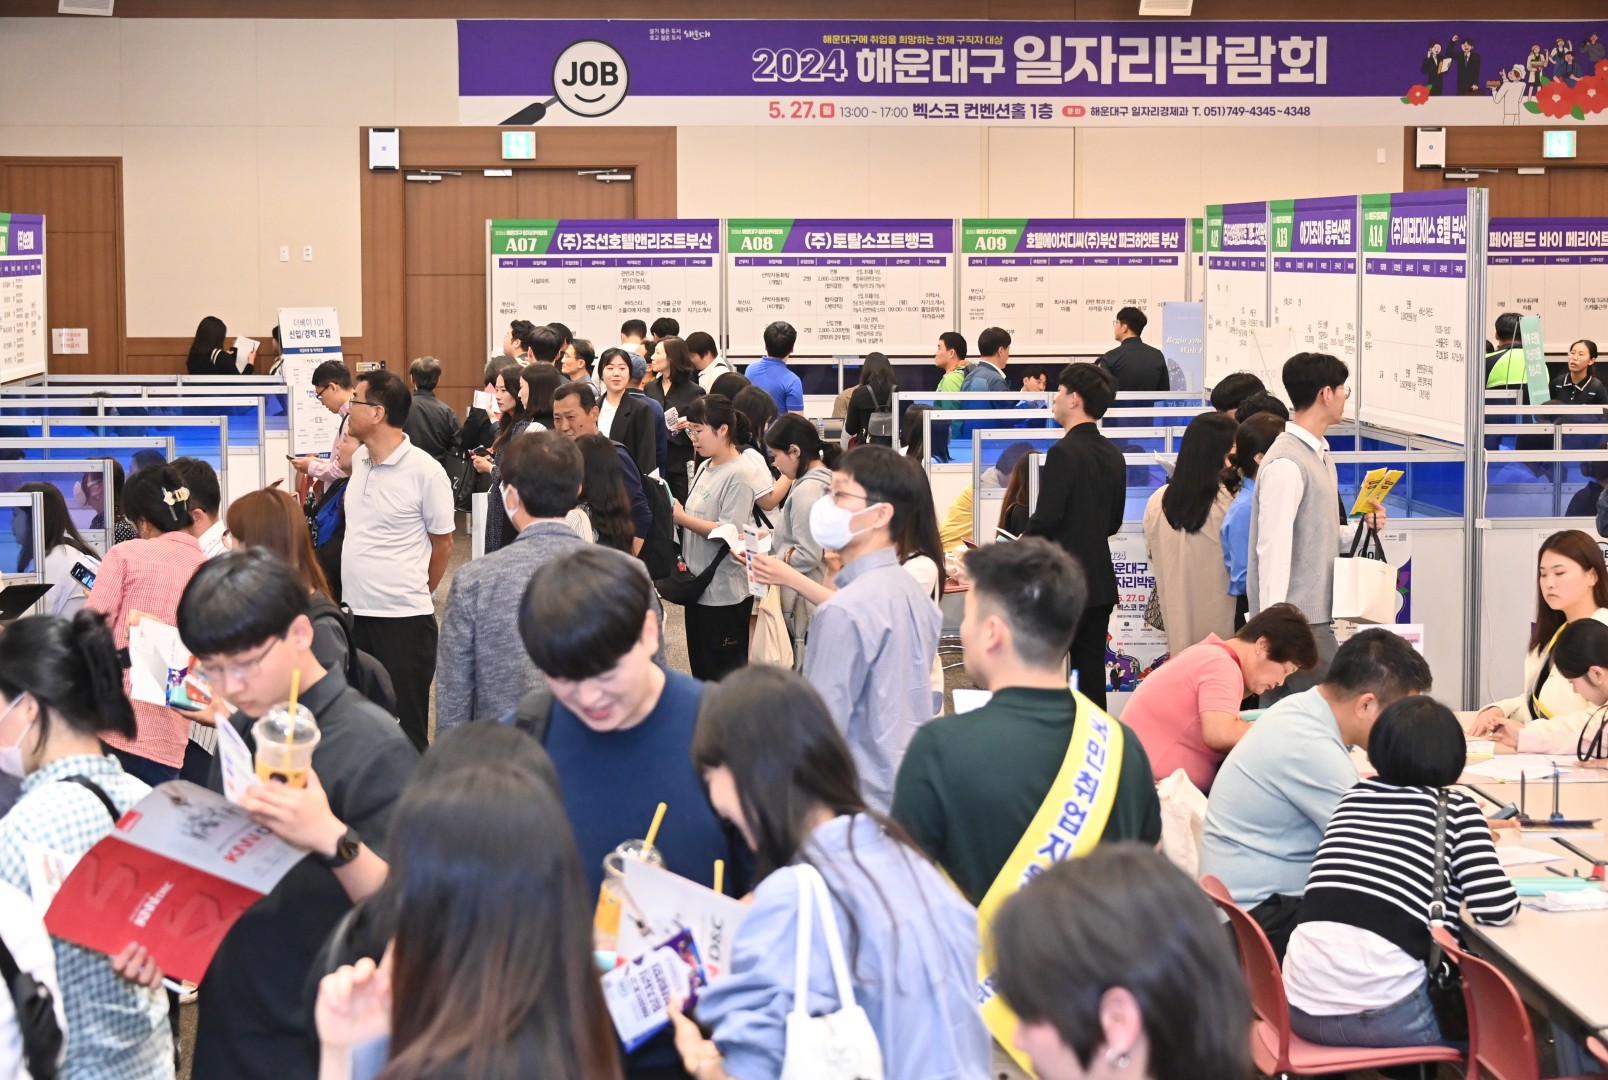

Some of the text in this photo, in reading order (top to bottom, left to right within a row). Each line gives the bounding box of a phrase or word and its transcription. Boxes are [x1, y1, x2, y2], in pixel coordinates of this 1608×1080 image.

[823, 35, 1003, 45] 해운대구에 취업을 희망하는 전체 구직자 대상
[752, 36, 1328, 85] 2024 해운대구 일자리박람회
[562, 61, 619, 88] JOB
[768, 101, 786, 119] 5.
[790, 101, 816, 119] 27.
[840, 107, 868, 118] 13:00
[880, 107, 908, 118] 17:00
[912, 103, 960, 120] 벡스코
[964, 103, 1026, 120] 컨벤션홀
[1030, 103, 1054, 120] 1층
[1090, 106, 1311, 117] 해운대구 일자리경제과 T. 051)749-4345~4348
[1276, 228, 1288, 247] A13
[1325, 219, 1351, 245] 동부산점
[1368, 225, 1384, 247] A14
[1391, 214, 1466, 246] (주)파라다이스 호텔 부산
[506, 237, 538, 252] A07
[557, 232, 712, 250] (주)조선호텔앤리조트부산
[740, 236, 774, 250] A08
[804, 232, 934, 250] (주)토탈소프트뱅크
[975, 236, 1007, 250] A09
[1026, 232, 1118, 249] 호텔에이치디씨(주)부산
[1161, 232, 1178, 249] 부산
[1489, 231, 1536, 248] 페어필드
[1540, 231, 1562, 248] 바이
[293, 318, 324, 328] 더베이 101
[319, 330, 330, 338] 모집
[1167, 336, 1188, 344] Begin
[1113, 562, 1148, 574] 운대구
[1116, 576, 1156, 588] 자리박
